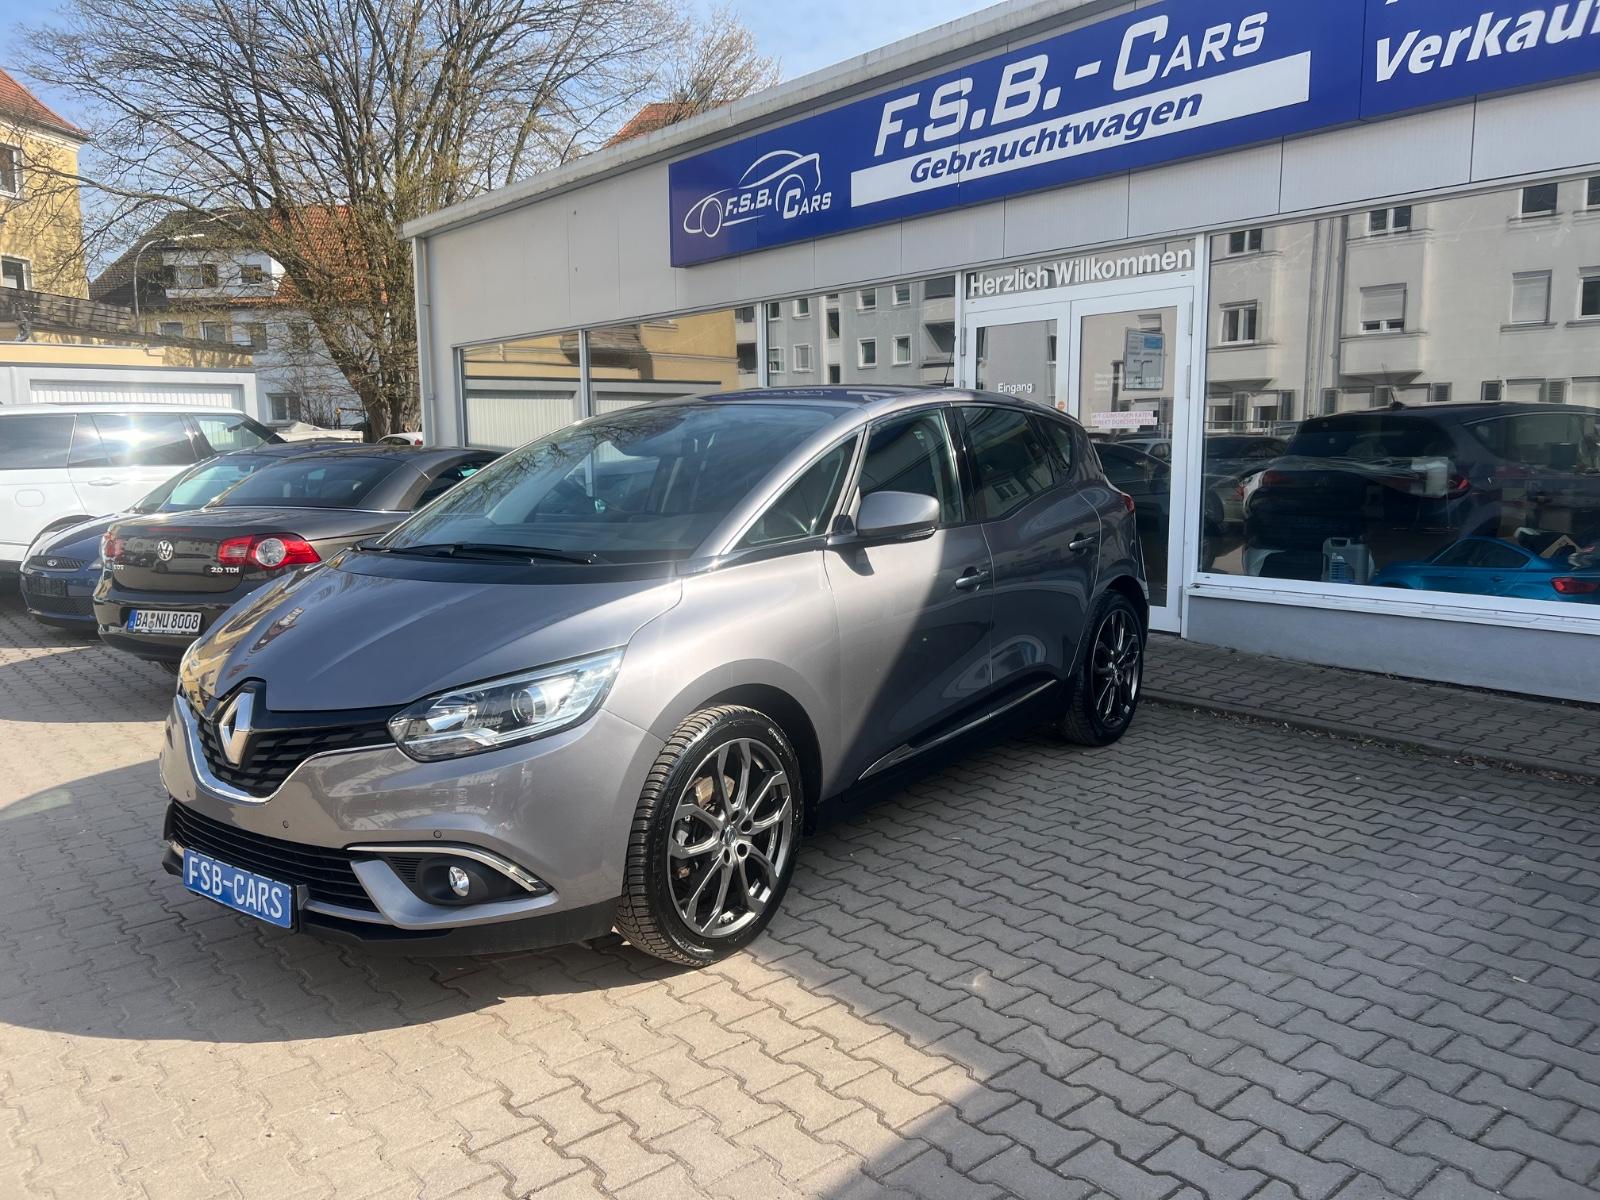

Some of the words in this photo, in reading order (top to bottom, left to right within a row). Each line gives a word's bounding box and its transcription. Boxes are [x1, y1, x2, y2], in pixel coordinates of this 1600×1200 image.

[910, 93, 1203, 184] Gebrauchtwagen
[725, 188, 772, 217] F.S.B.
[783, 187, 832, 219] CARS
[969, 266, 1049, 297] Herzlich
[1053, 248, 1192, 286] Willkommen
[997, 382, 1033, 394] Eingang
[135, 612, 148, 628] BA
[171, 613, 199, 629] 8008
[188, 856, 283, 919] FSB-CARS
